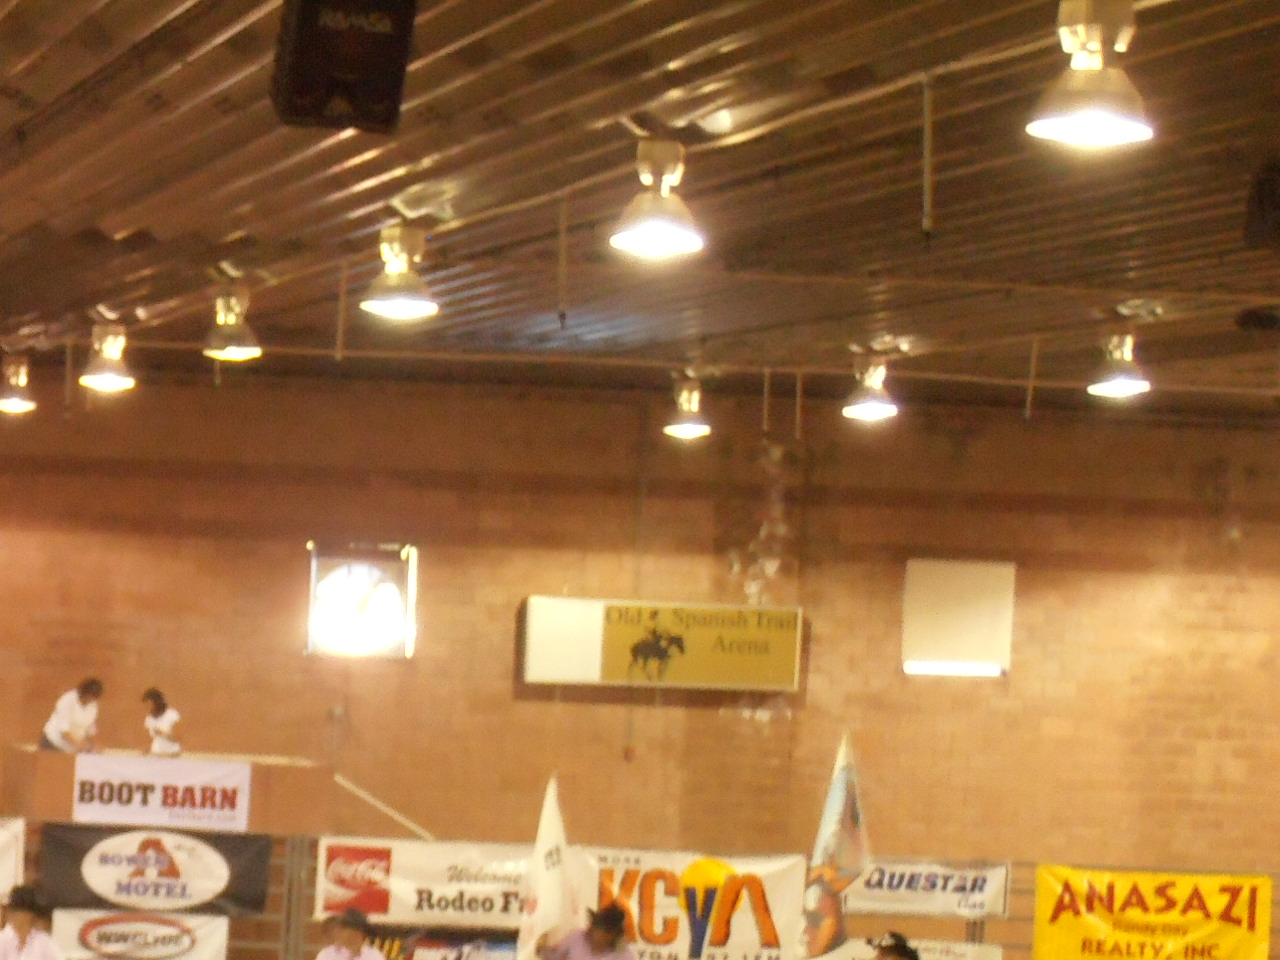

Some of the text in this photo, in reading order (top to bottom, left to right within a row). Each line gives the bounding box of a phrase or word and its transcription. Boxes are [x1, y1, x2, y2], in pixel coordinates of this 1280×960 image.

[78, 780, 238, 811] BOOT BARN
[116, 881, 192, 899] MOTEL
[865, 868, 988, 893] QUESTAR
[415, 888, 495, 913] Rodeo
[1048, 879, 1259, 933] ANASAZI
